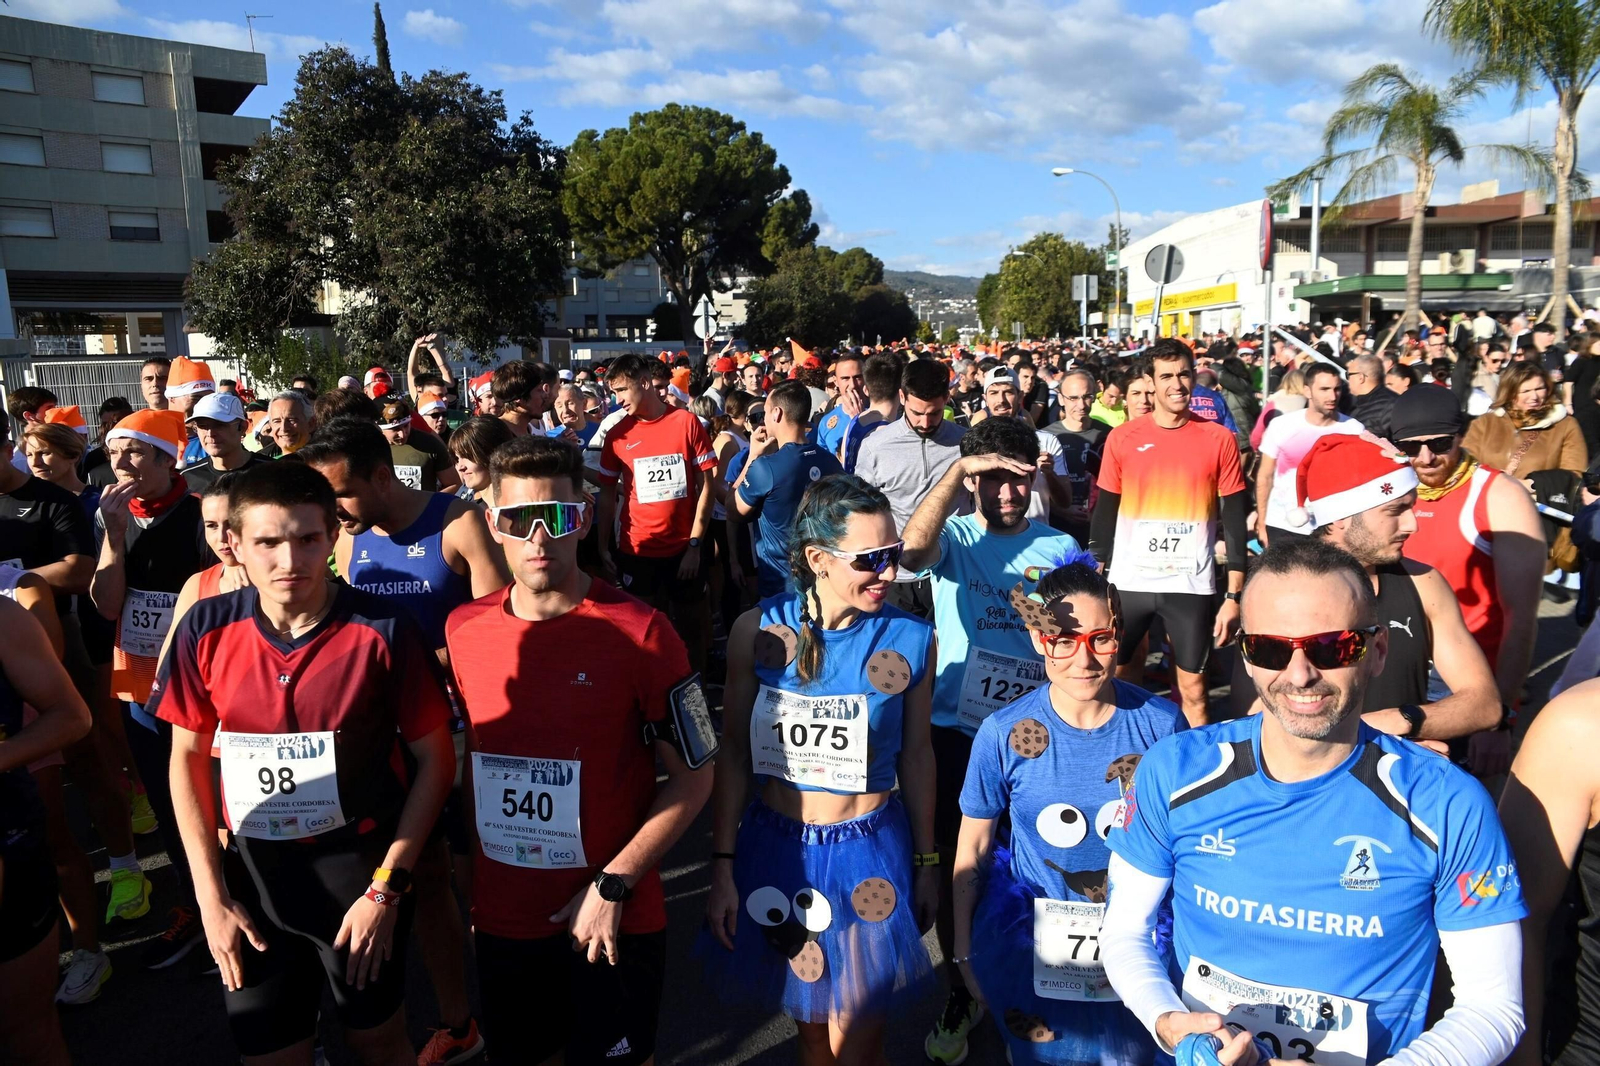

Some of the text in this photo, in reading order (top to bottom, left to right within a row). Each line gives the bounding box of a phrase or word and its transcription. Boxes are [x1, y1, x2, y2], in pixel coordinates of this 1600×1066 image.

[648, 468, 672, 483] 221
[1149, 537, 1181, 552] 847
[132, 609, 162, 630] 537
[981, 676, 1036, 702] 123
[811, 699, 839, 709] 2024
[276, 735, 300, 748] 2024
[772, 722, 849, 751] 1075
[822, 754, 863, 764] CORDOBESA
[529, 760, 555, 772] 2024
[765, 761, 794, 773] IMDECO
[258, 767, 296, 794] 98
[292, 800, 336, 808] CORDOBESA
[502, 788, 553, 822] 540
[242, 821, 267, 829] IMDECO
[311, 819, 329, 827] GCC
[504, 824, 538, 834] SILVESTRE
[538, 829, 577, 838] CORDOBESA
[490, 843, 514, 854] IMDECO
[1194, 884, 1384, 938] TROTASIERRA
[1070, 966, 1105, 974] SILVESTR
[1049, 980, 1082, 990] IMDECO
[1224, 978, 1261, 994] PROVINCIAL
[1273, 992, 1319, 1008] 2024
[1230, 987, 1273, 1004] POPULARES
[606, 1047, 632, 1057] adidas
